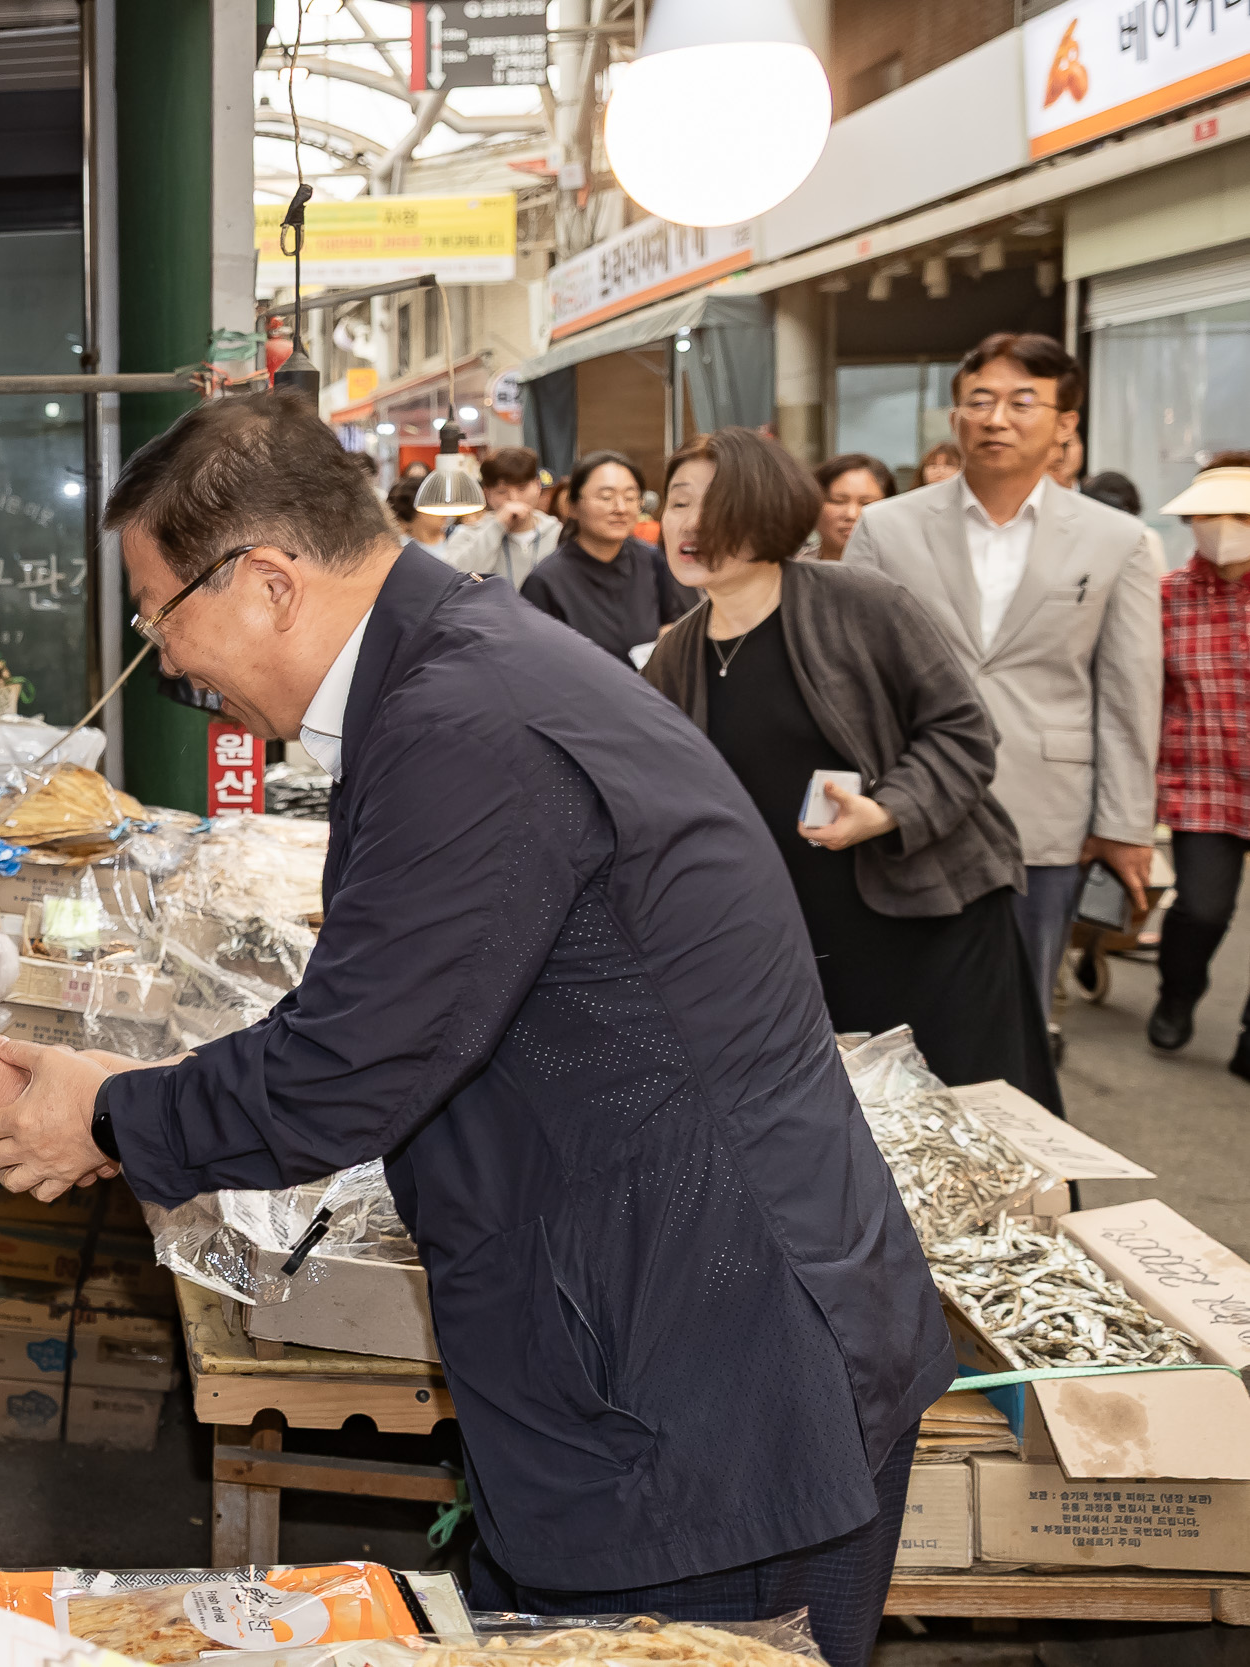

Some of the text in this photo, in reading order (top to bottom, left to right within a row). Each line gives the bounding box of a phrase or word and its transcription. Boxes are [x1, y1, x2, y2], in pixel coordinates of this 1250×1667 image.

[1029, 1490, 1047, 1500] 보관
[1060, 1491, 1088, 1501] 습기와
[1093, 1491, 1121, 1502] 햇빛을
[1125, 1492, 1156, 1502] 피하고
[1160, 1493, 1183, 1504] (냉장
[1188, 1494, 1212, 1505] 보관)
[1061, 1502, 1196, 1516] 유통 과정중 변질시 본사 또는
[1062, 1514, 1109, 1524] 판매처에서
[1113, 1515, 1153, 1525] 교환하여
[1133, 1528, 1173, 1537] 국번없이
[1177, 1529, 1200, 1538] 1399
[1118, 1538, 1141, 1548] 주의)
[205, 1590, 227, 1624] Fresh dried
